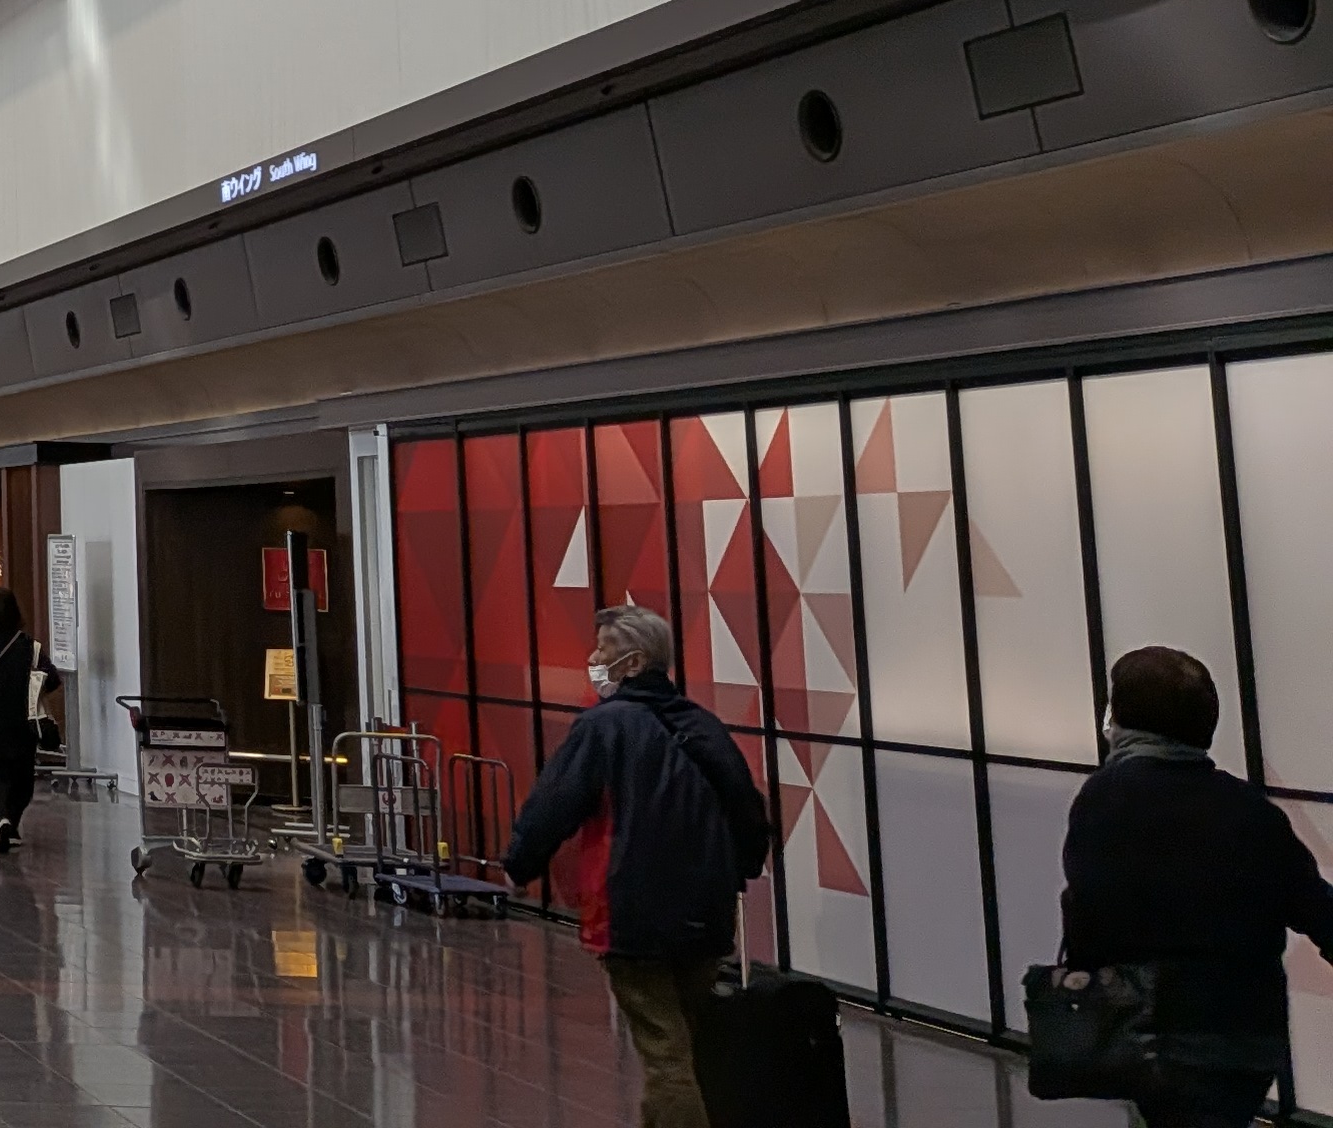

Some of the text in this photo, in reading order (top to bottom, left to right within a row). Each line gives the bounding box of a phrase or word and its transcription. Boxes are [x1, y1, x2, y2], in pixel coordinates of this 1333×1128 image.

[269, 152, 317, 182] South Wing
[221, 166, 262, 203] 南ウイング
